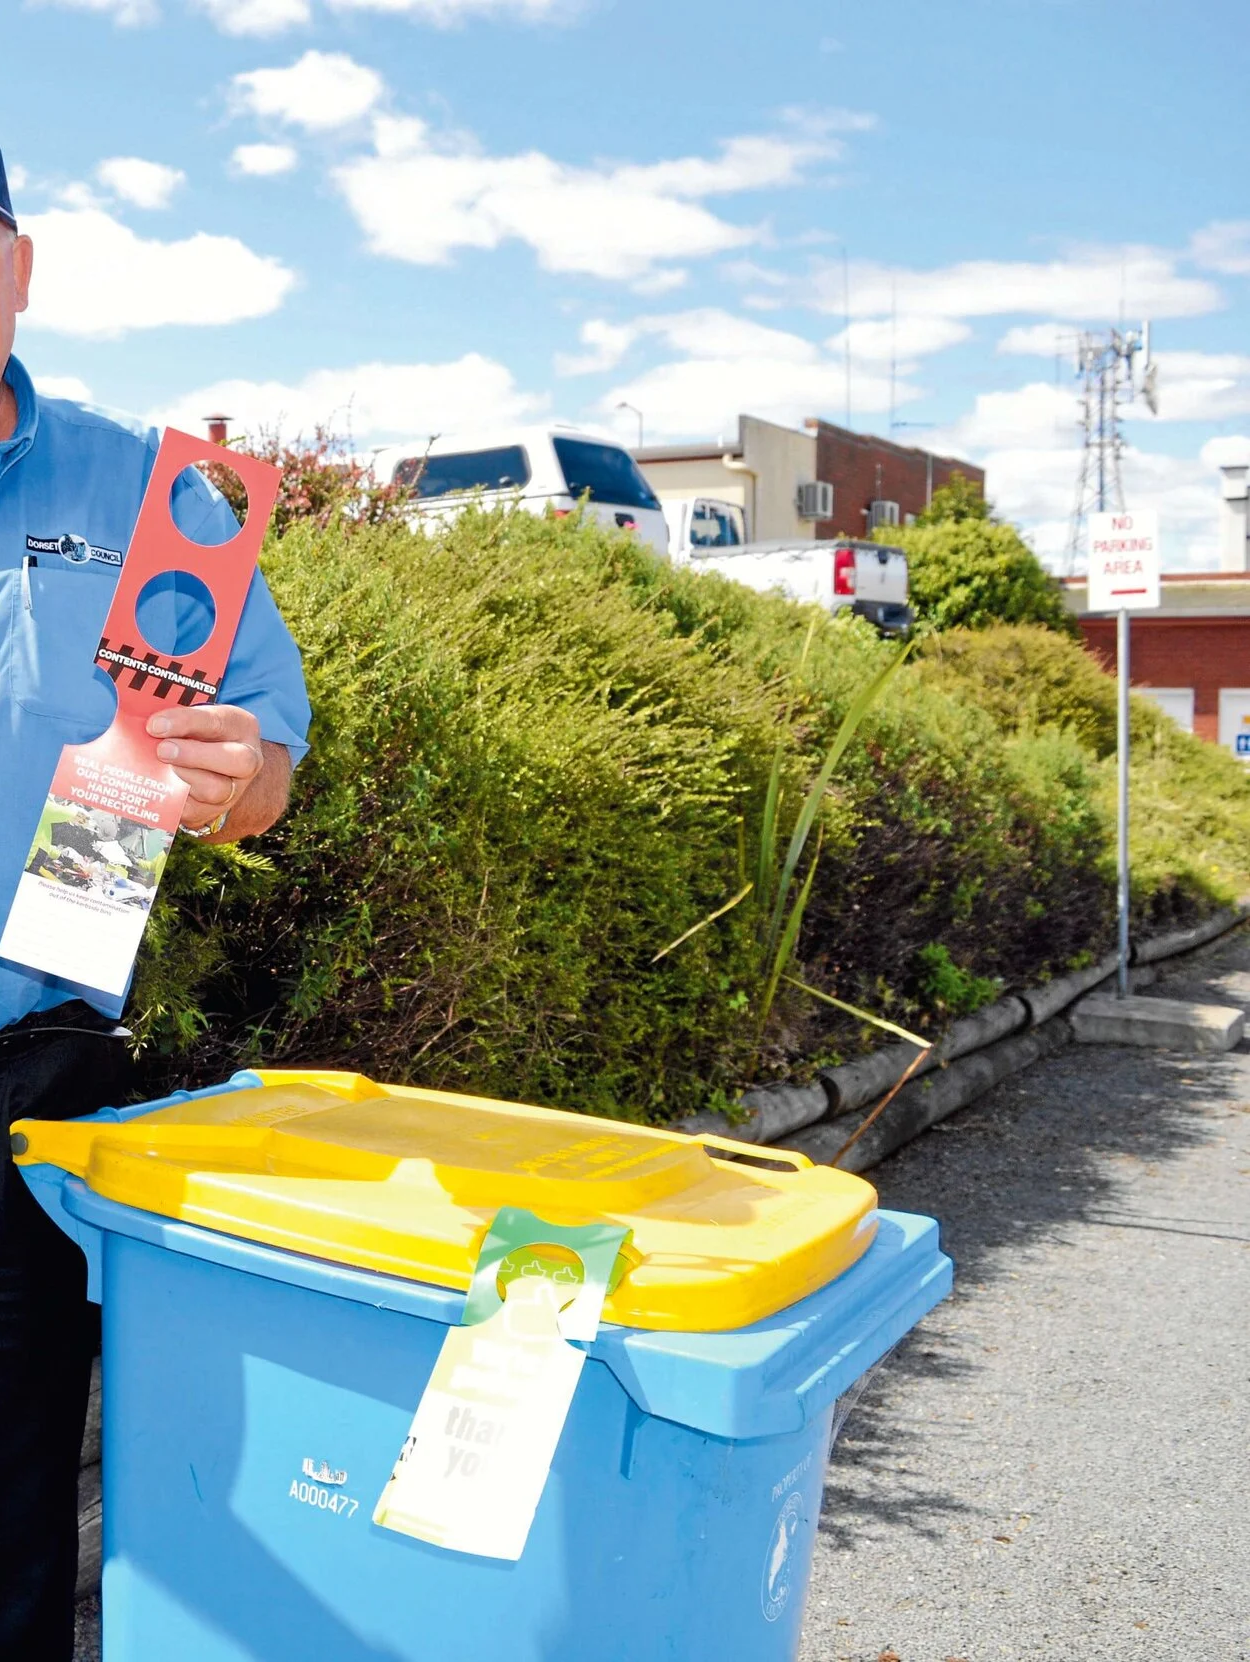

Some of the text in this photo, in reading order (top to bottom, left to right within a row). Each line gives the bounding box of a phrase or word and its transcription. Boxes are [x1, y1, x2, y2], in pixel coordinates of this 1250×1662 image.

[1111, 515, 1134, 531] NO
[27, 538, 121, 563] DORSET COUNCIL
[1092, 536, 1154, 554] PARKING
[1103, 559, 1144, 575] AREA
[98, 648, 217, 695] CONTENTS CONTAMINATED
[74, 755, 175, 795] REAL PEOPLE FROM
[76, 767, 166, 802] OUR COMMUNITY
[71, 786, 160, 822] YOUR RECYCLING
[87, 781, 150, 807] HAND SORT
[37, 880, 56, 891] Please
[90, 897, 130, 914] contamination
[442, 1444, 491, 1481] yo
[288, 1479, 360, 1519] A000477
